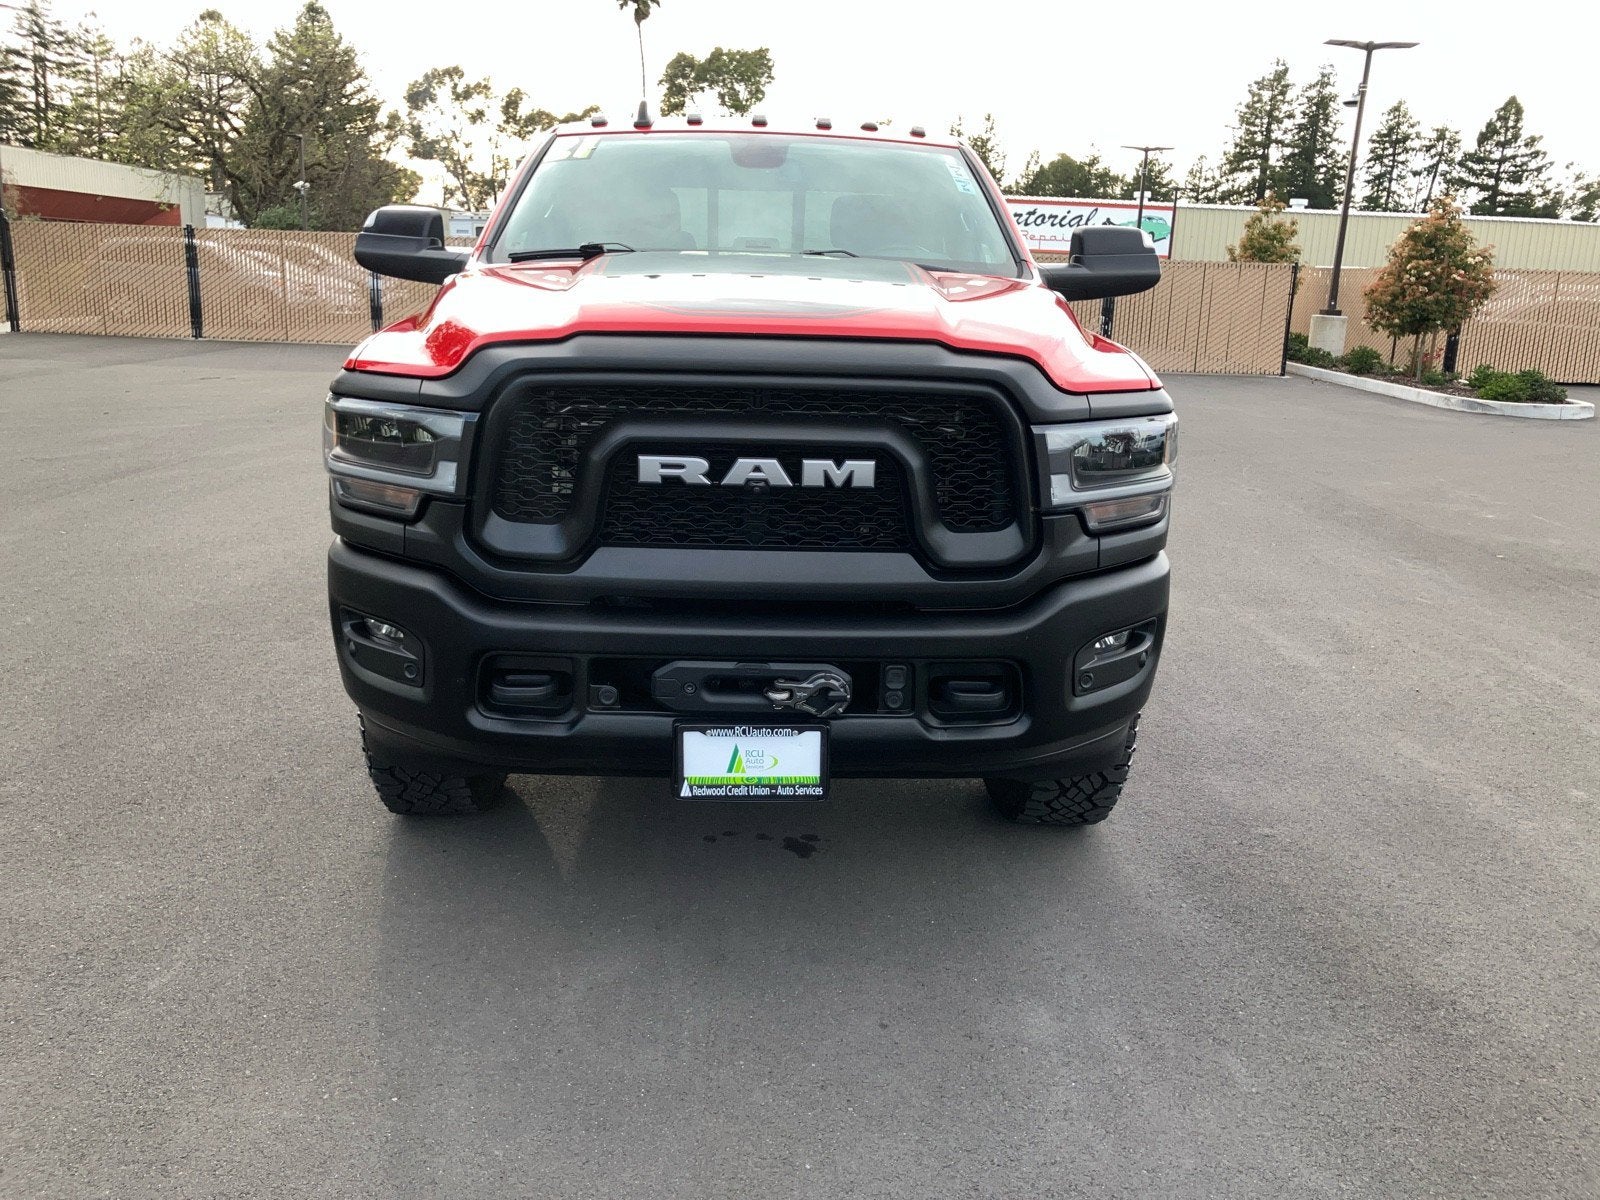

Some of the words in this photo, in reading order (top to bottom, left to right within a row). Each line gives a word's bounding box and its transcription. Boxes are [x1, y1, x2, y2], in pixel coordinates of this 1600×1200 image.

[637, 454, 876, 488] RAM
[711, 726, 792, 737] www.RCUauto.com
[745, 749, 764, 758] RCU
[692, 786, 726, 796] Redwood
[727, 786, 748, 796] Credit
[748, 786, 770, 796] Union
[777, 785, 794, 796] Auto
[795, 785, 823, 796] Services
